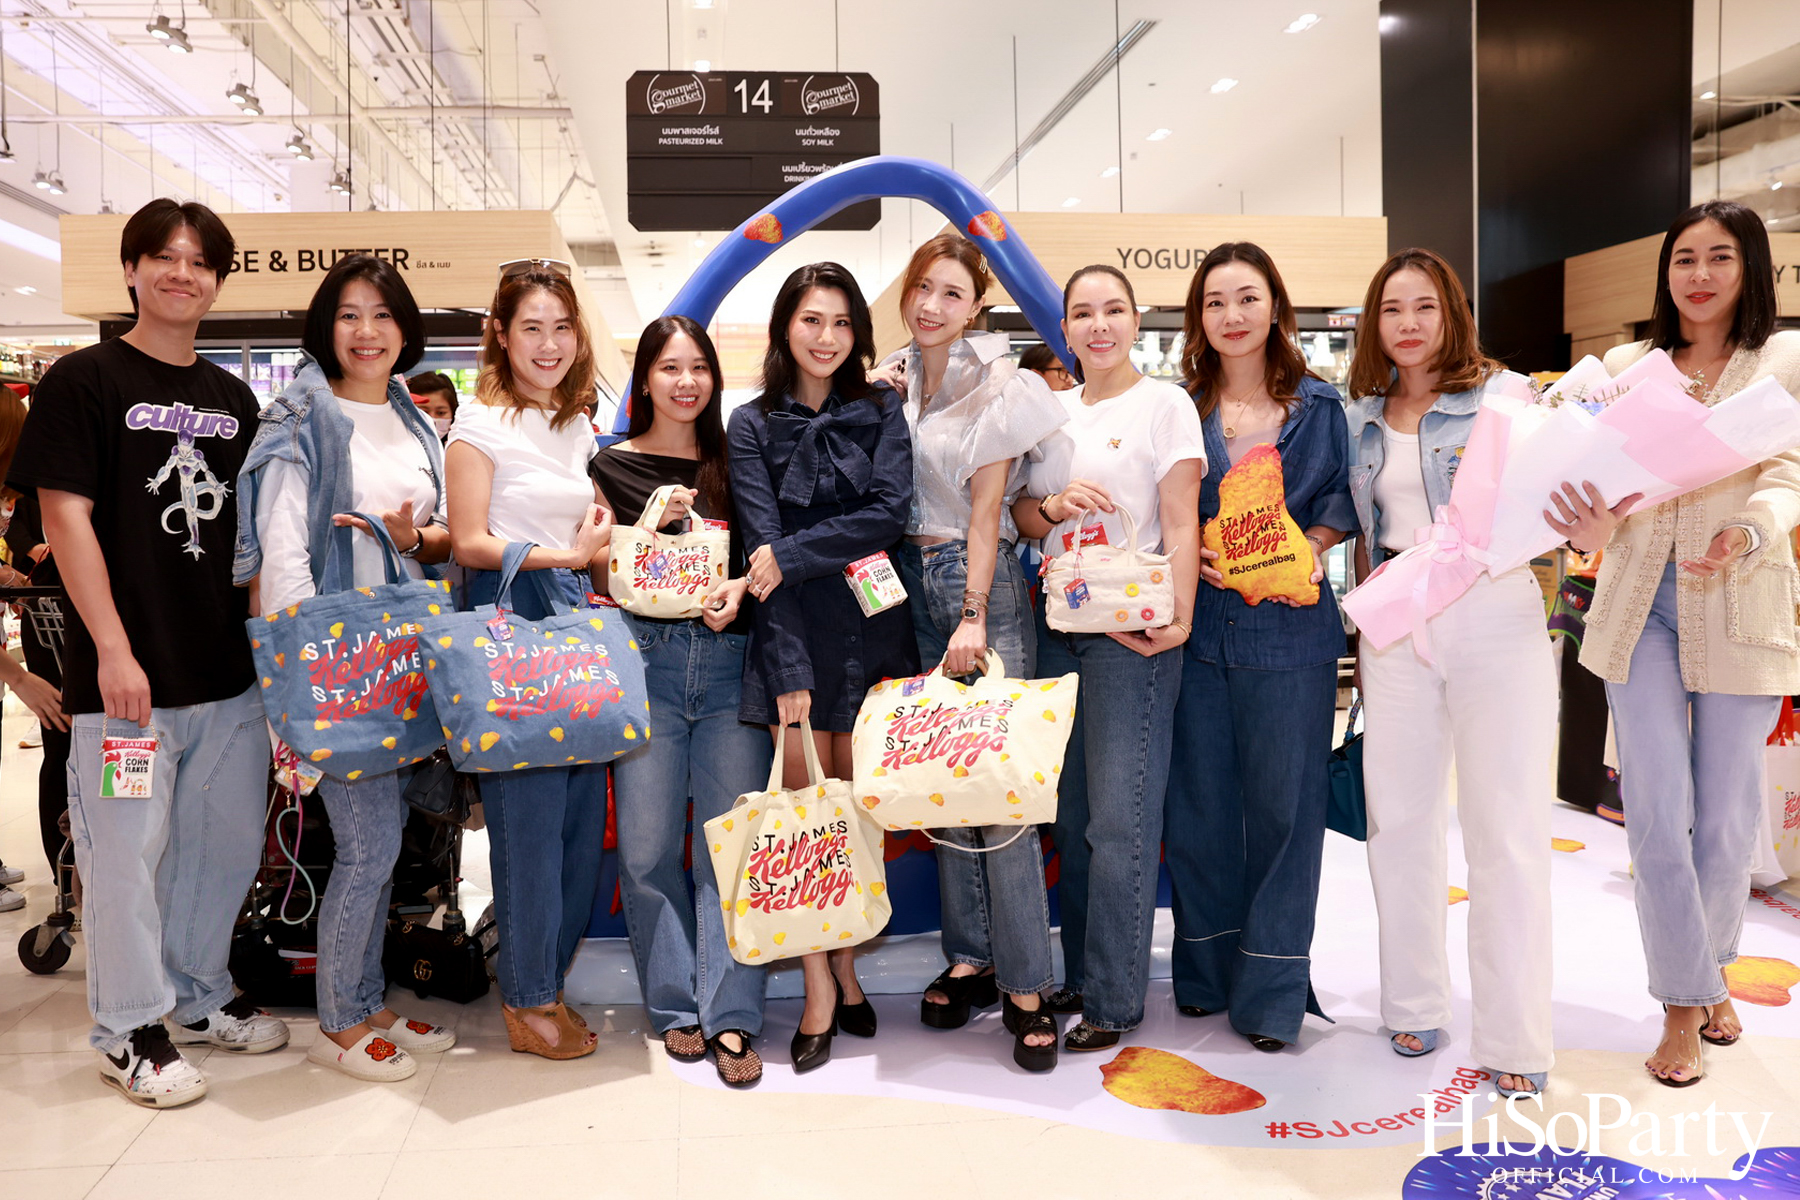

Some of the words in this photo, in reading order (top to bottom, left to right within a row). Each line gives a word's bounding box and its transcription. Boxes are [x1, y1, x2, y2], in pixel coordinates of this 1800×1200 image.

[665, 89, 702, 107] market
[734, 78, 773, 114] 14
[819, 91, 855, 107] market
[658, 137, 704, 146] PASTEURIZED
[706, 137, 723, 146] MILK
[801, 138, 815, 147] SOY
[816, 138, 834, 147] MILK
[269, 249, 288, 272] &
[1116, 248, 1209, 270] YOGUR
[125, 401, 239, 439] culture
[873, 566, 891, 578] CORN
[1228, 553, 1296, 576] #SJcerealbag
[304, 624, 416, 660] ST.JAME
[311, 652, 421, 702] ST.JAME
[124, 766, 149, 774] FLAKES
[125, 758, 149, 766] CORN
